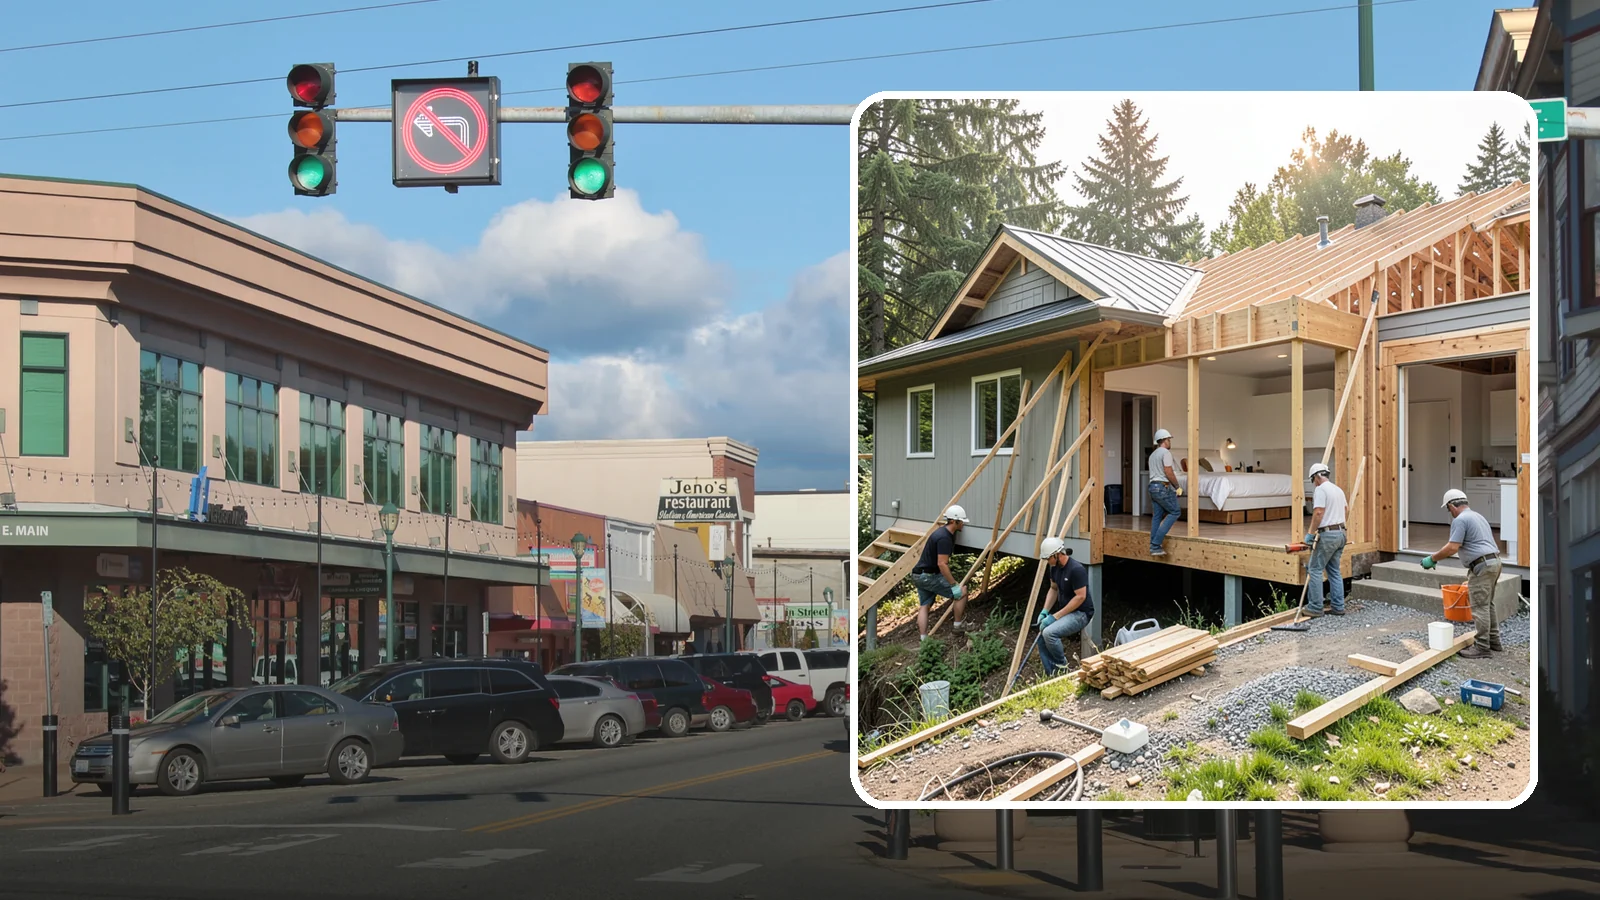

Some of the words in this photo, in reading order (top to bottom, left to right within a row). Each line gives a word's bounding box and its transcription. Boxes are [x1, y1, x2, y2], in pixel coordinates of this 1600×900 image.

[670, 480, 727, 494] Jeno's
[665, 496, 731, 509] restaurant
[659, 510, 681, 519] Italian
[686, 509, 714, 519] American
[715, 509, 737, 519] Cuisine
[2, 525, 13, 536] E.
[15, 525, 49, 536] MAIN
[797, 607, 828, 616] Street
